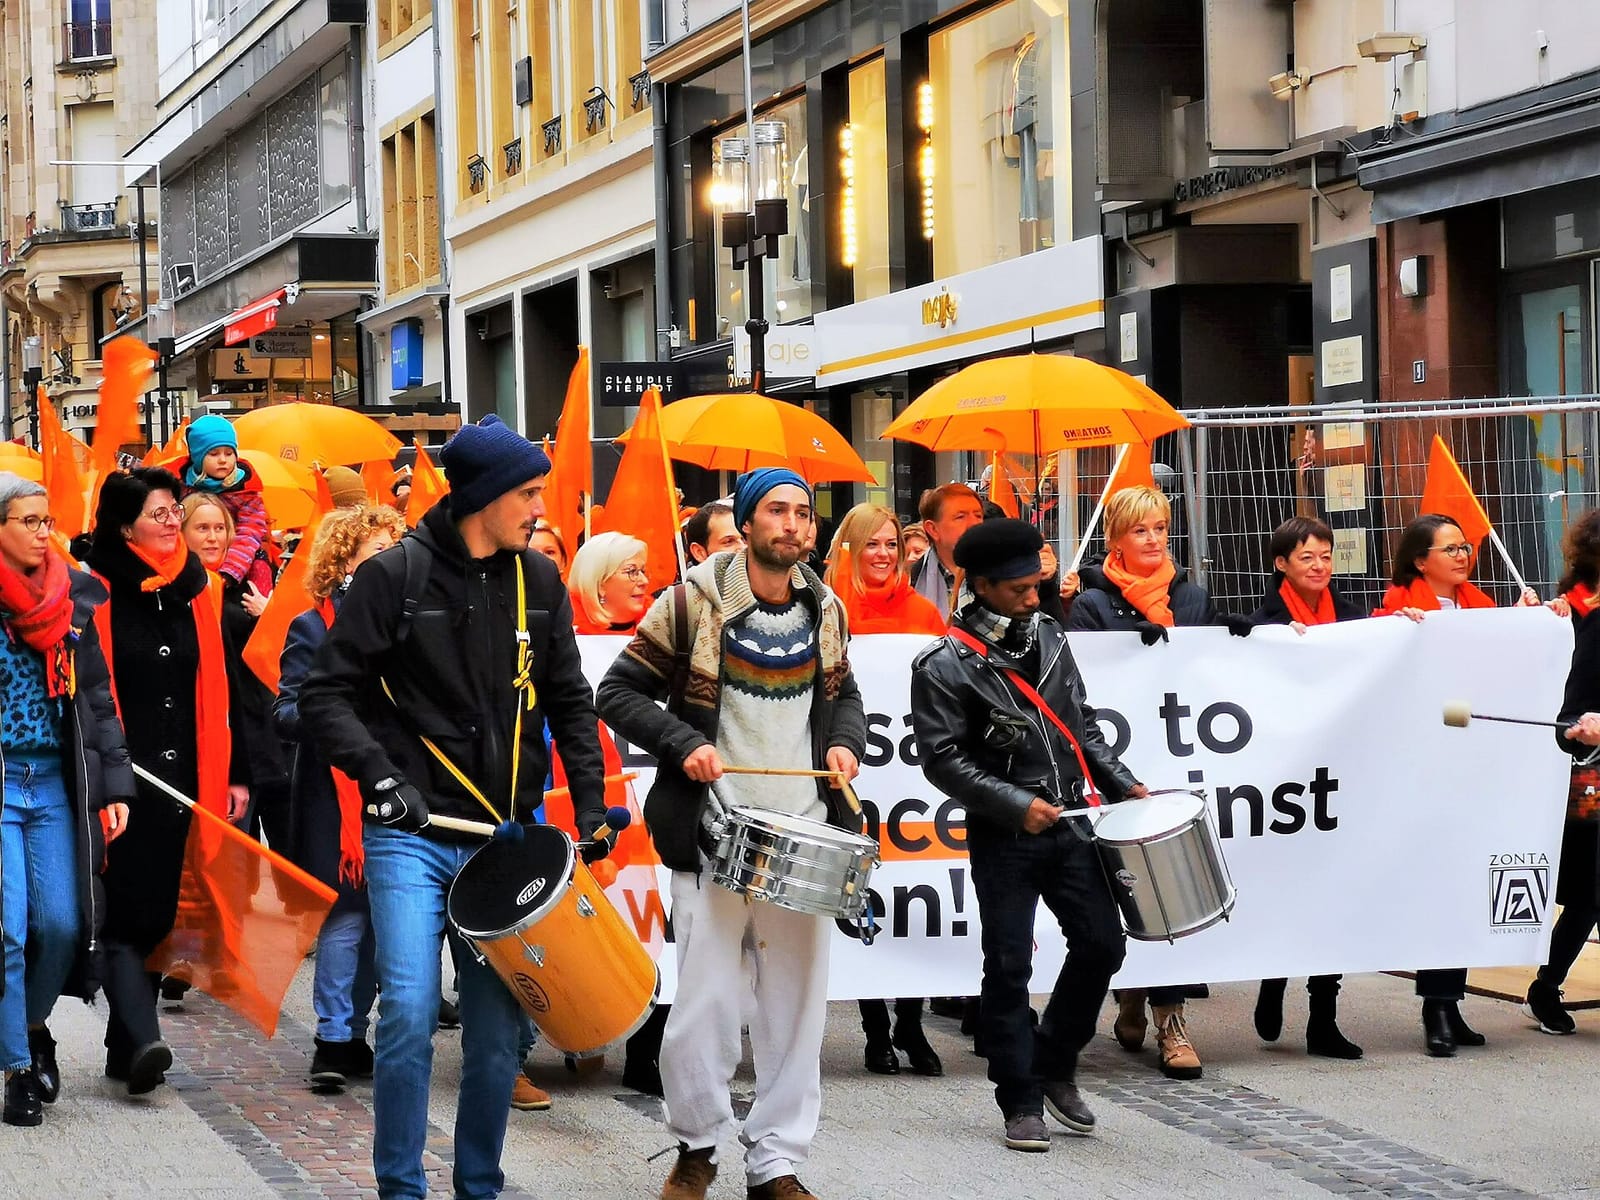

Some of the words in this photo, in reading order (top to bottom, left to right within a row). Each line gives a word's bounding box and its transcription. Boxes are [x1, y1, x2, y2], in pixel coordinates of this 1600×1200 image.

[605, 375, 673, 384] CLAUDIE
[1159, 692, 1253, 757] to
[1489, 852, 1550, 866] ZONTA
